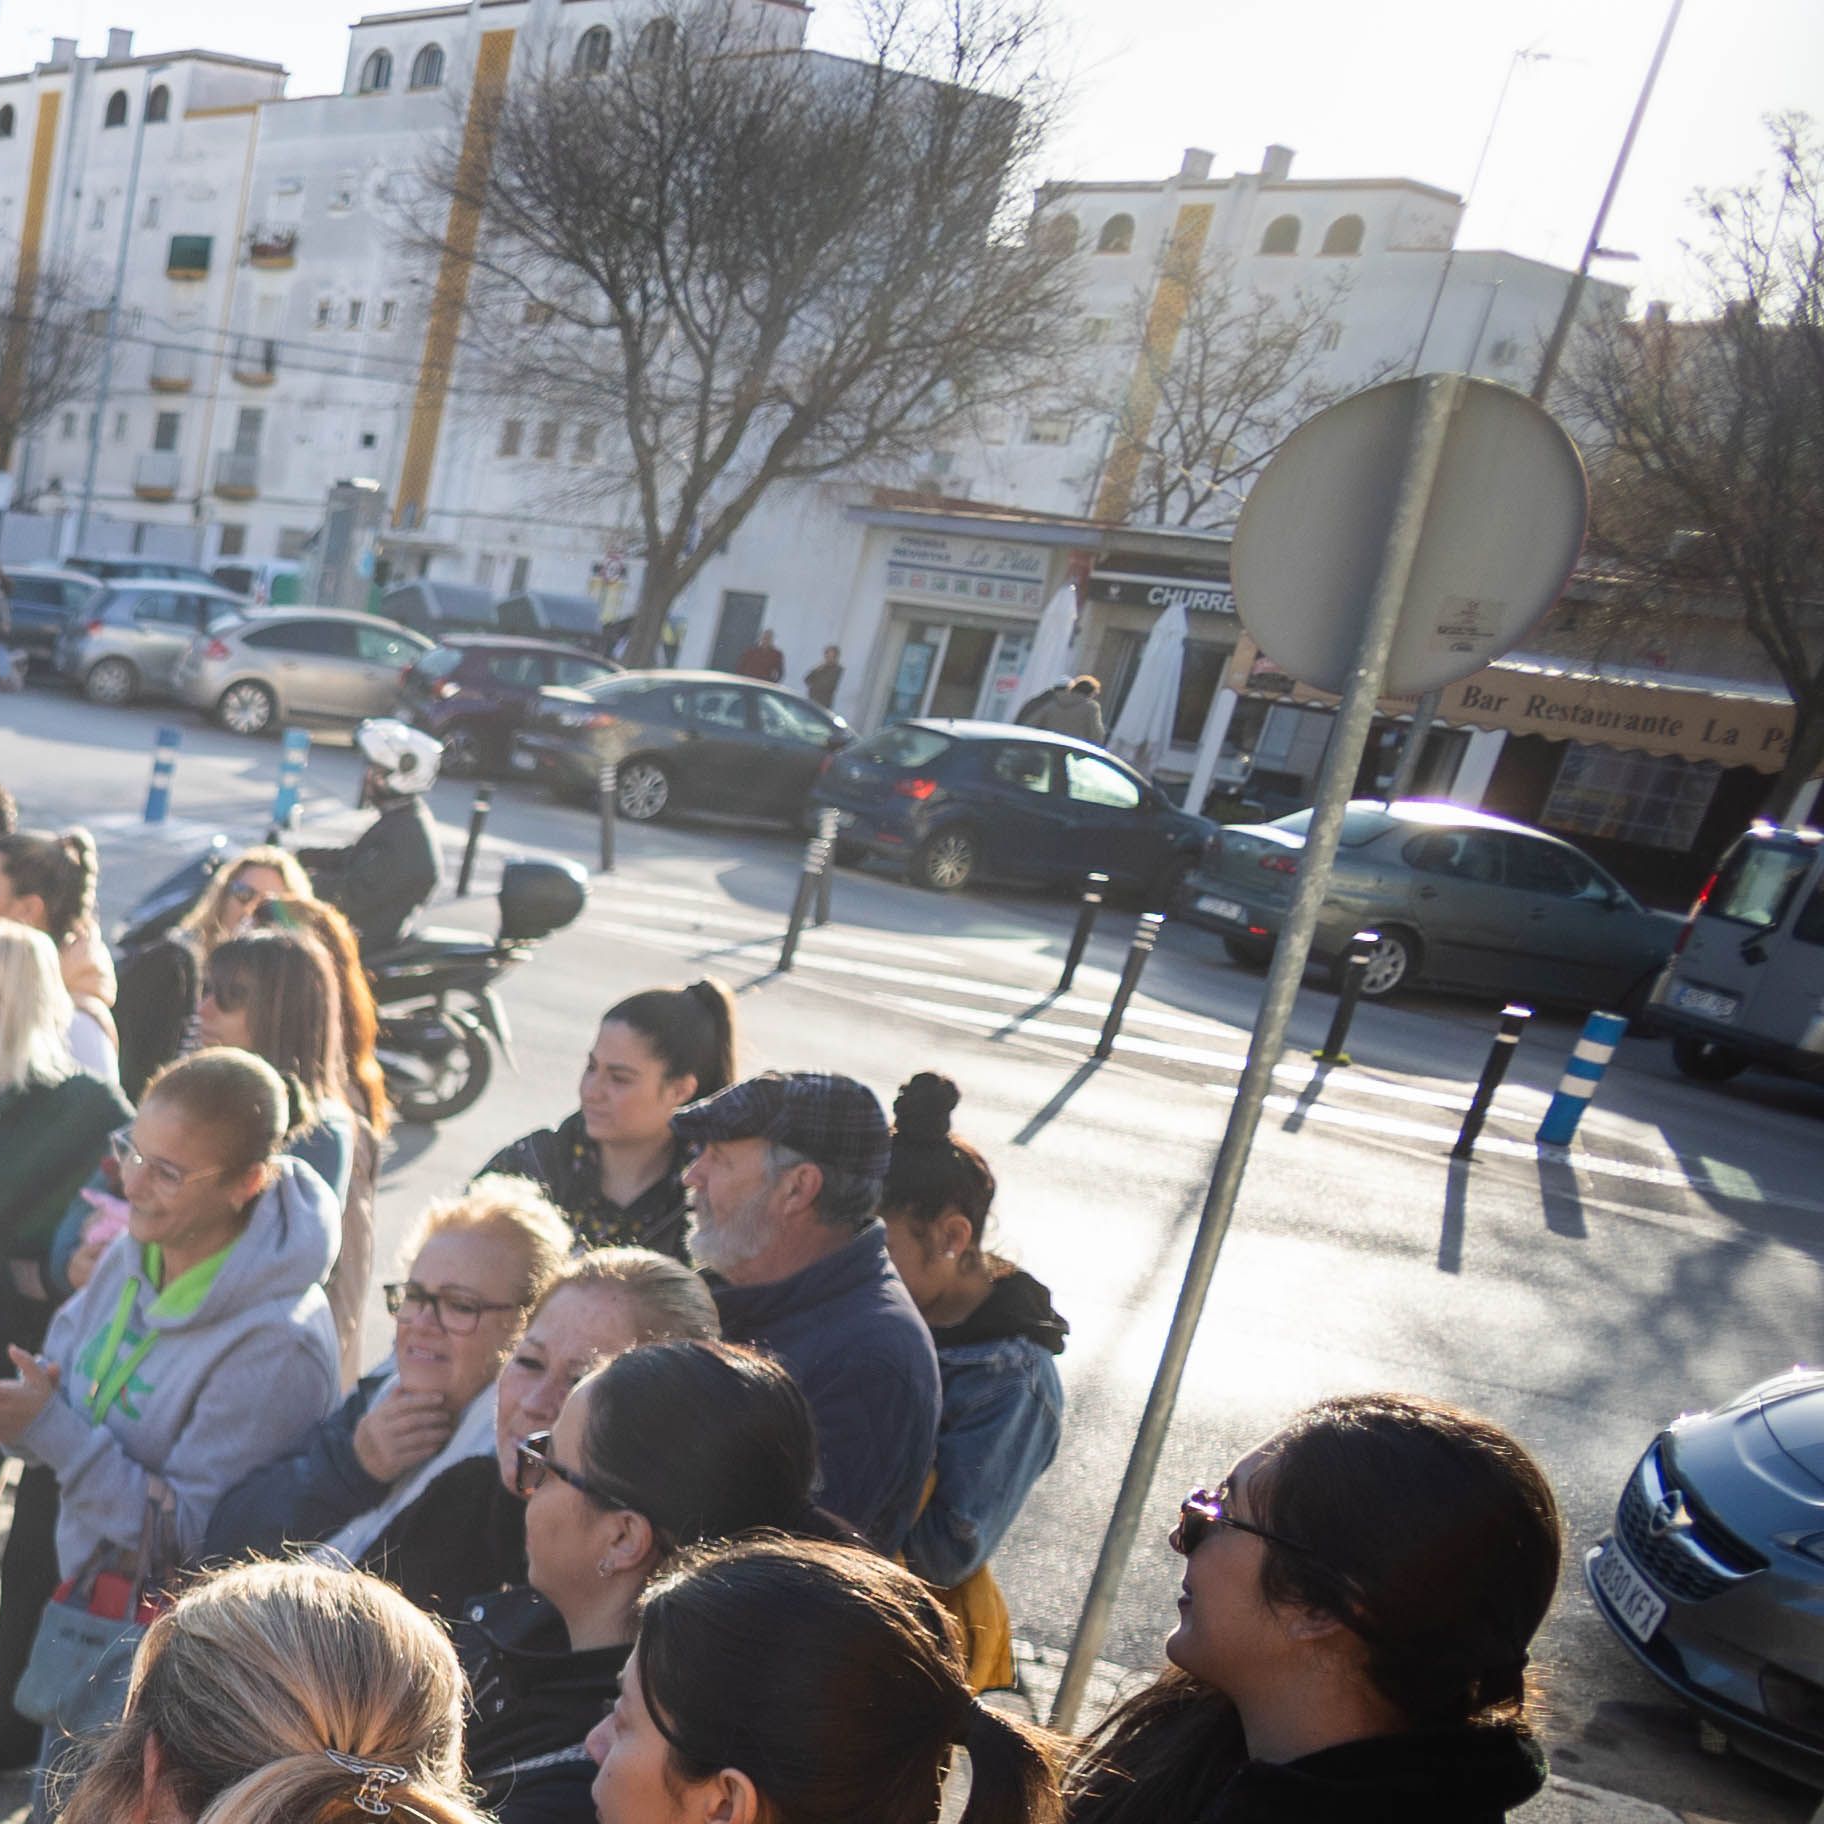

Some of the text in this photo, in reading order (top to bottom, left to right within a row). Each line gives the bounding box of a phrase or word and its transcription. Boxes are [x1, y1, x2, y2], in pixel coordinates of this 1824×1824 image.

[1460, 685, 1509, 712] Bar
[1523, 693, 1683, 737] Restaurante
[1701, 718, 1739, 747] La
